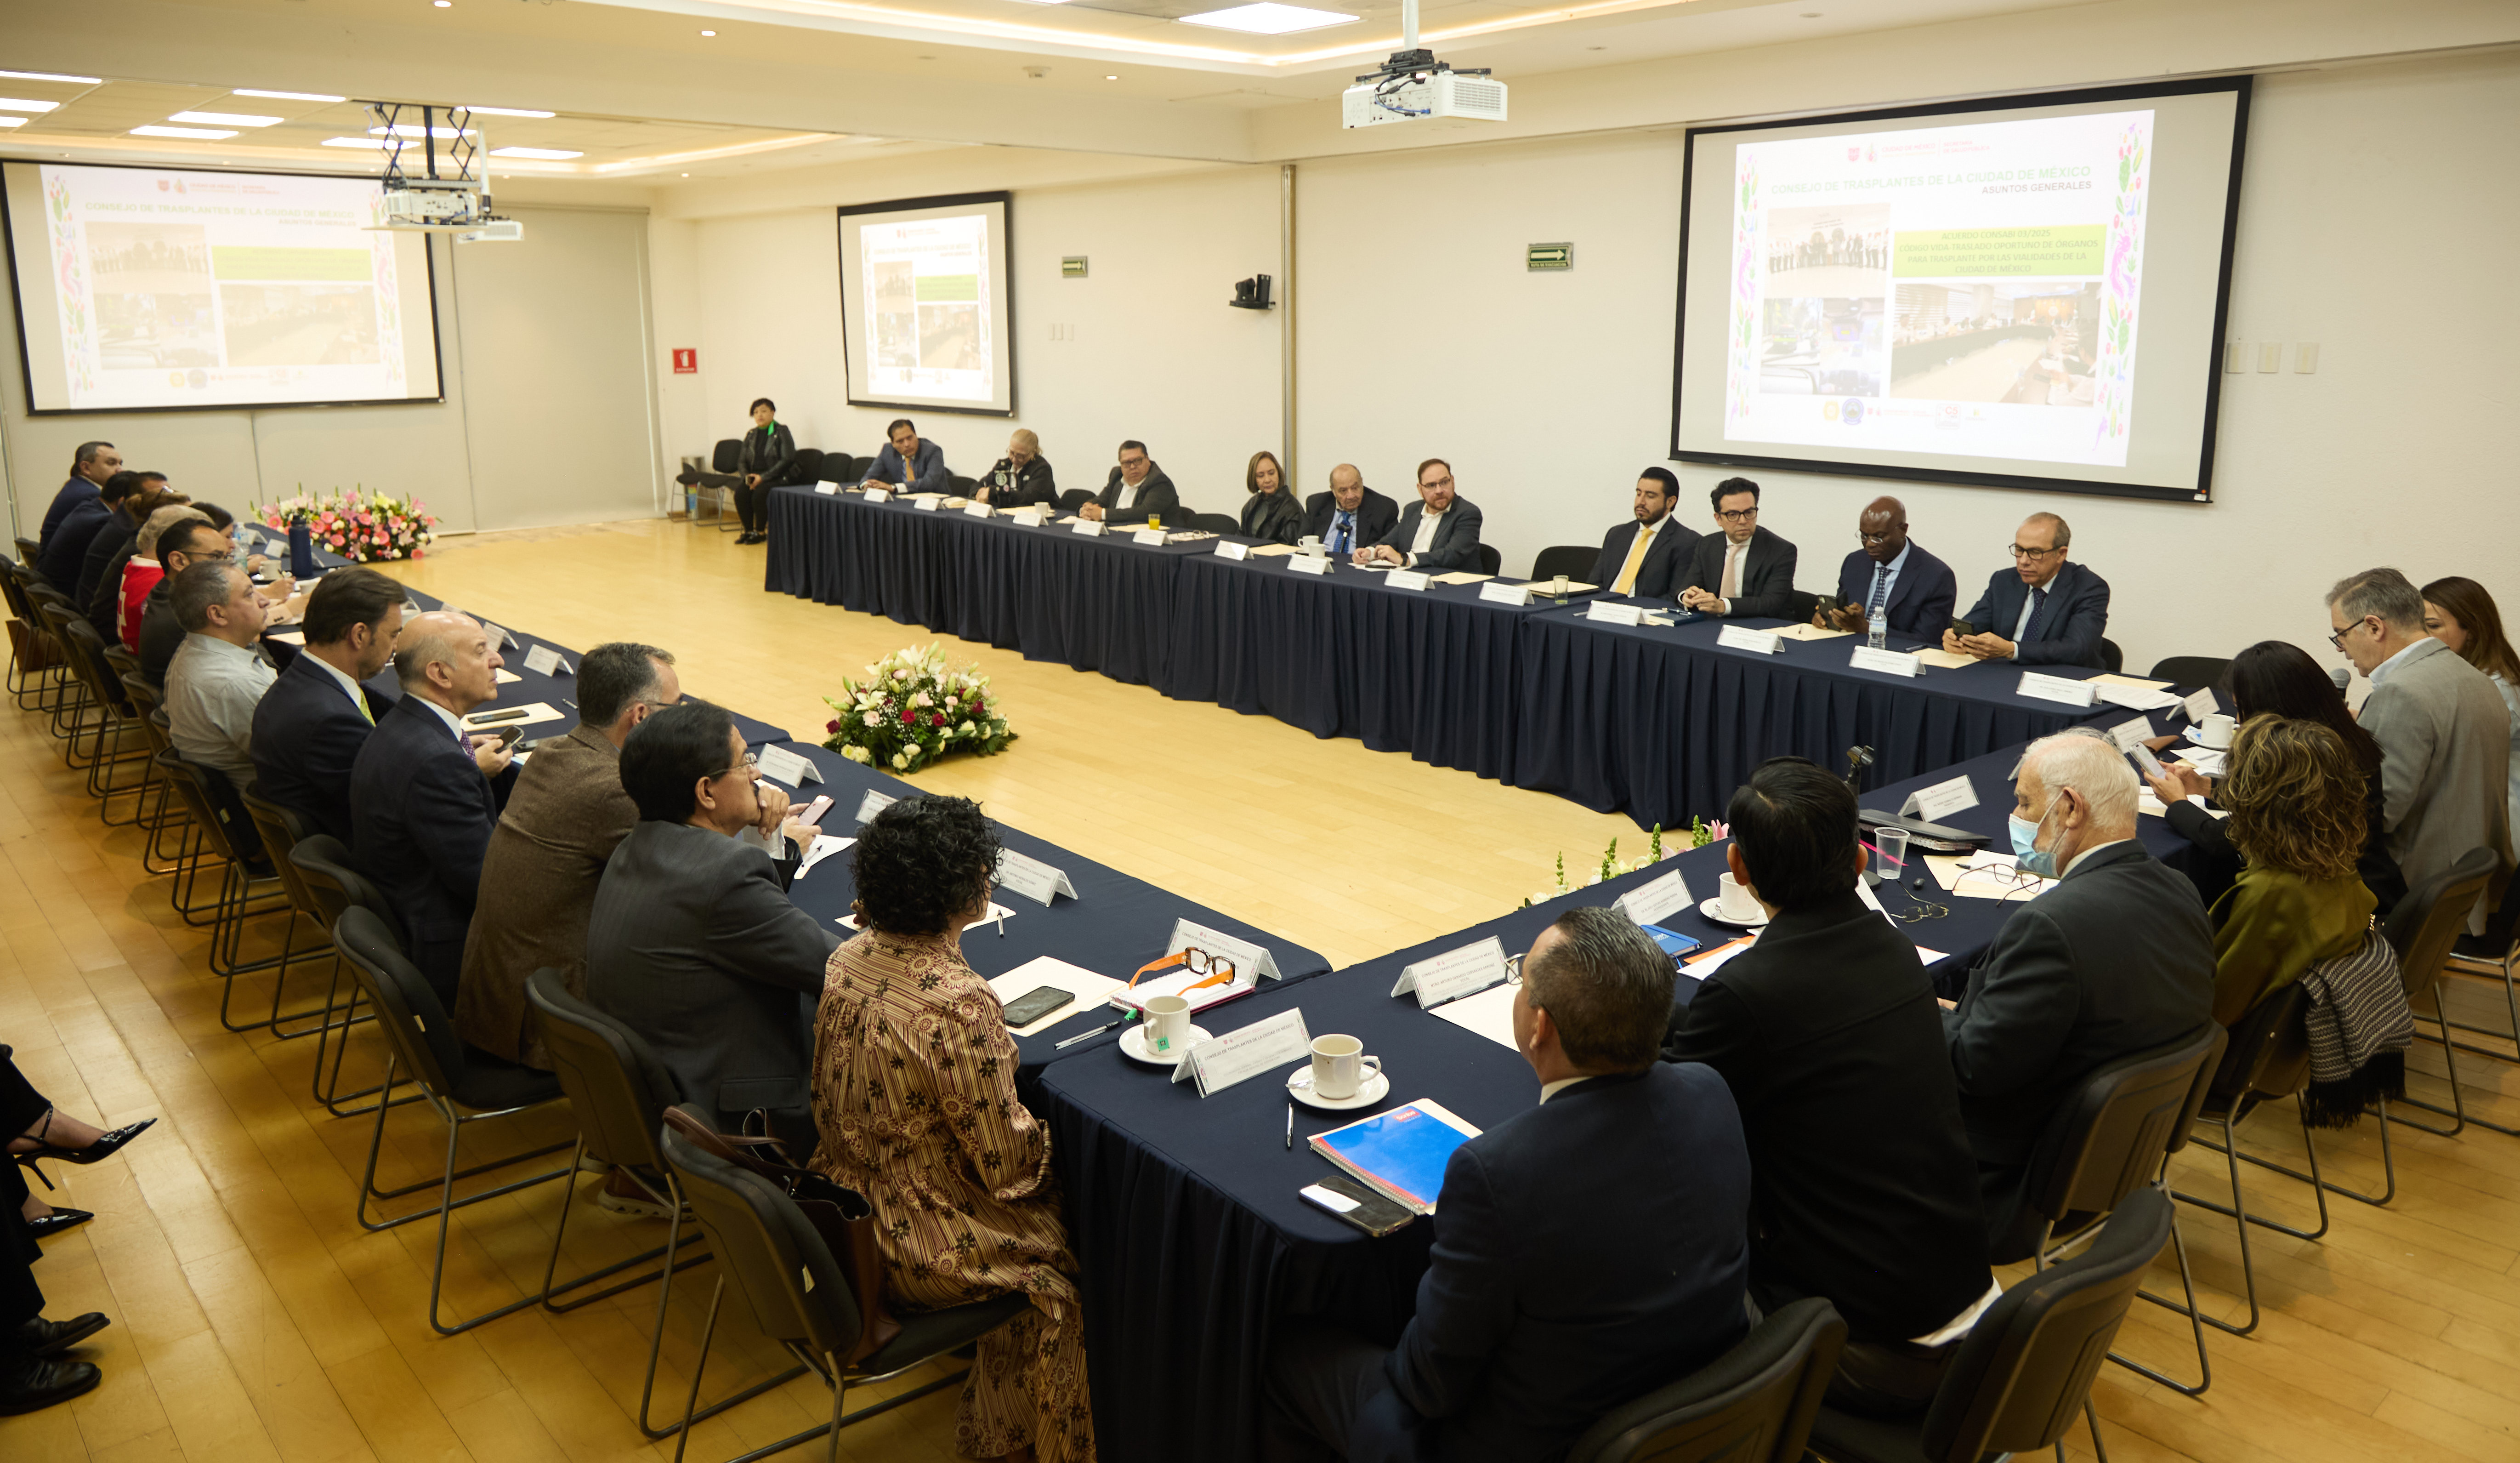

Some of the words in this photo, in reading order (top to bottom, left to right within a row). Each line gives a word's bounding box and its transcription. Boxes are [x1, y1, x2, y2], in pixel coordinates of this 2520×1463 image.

[1772, 182, 1821, 194] CONSEJO
[1825, 181, 1839, 192] DE
[1843, 176, 1924, 190] TRASPLANTES
[1928, 175, 1944, 185] DE
[1948, 174, 1963, 184] LA
[1967, 170, 2014, 183] CIUDAD
[2018, 169, 2034, 180] DE
[2039, 165, 2091, 179] MÉXICO
[1982, 184, 2028, 194] ASUNTOS
[2031, 181, 2092, 191] GENERALES
[85, 202, 137, 212] CONSEJO
[140, 204, 154, 213] DE
[158, 204, 231, 215] TRASPLANTES
[233, 207, 246, 215] DE
[265, 208, 301, 217] CIUDAD
[1981, 230, 2015, 239] CONSABI
[2018, 229, 2050, 238] 03/2025
[1899, 243, 1929, 252] CÓDIGO
[1994, 241, 2040, 250] OPORTUNO
[2043, 240, 2053, 248] DE
[2055, 239, 2098, 248] ÓRGANOS
[2013, 252, 2060, 261] VIALIDADES
[2000, 264, 2032, 272] MÉXICO
[1204, 1052, 1221, 1061] CONSEJO
[1228, 1040, 1252, 1052] TRASPLANTES
[1263, 1030, 1276, 1038] CIUDAD
